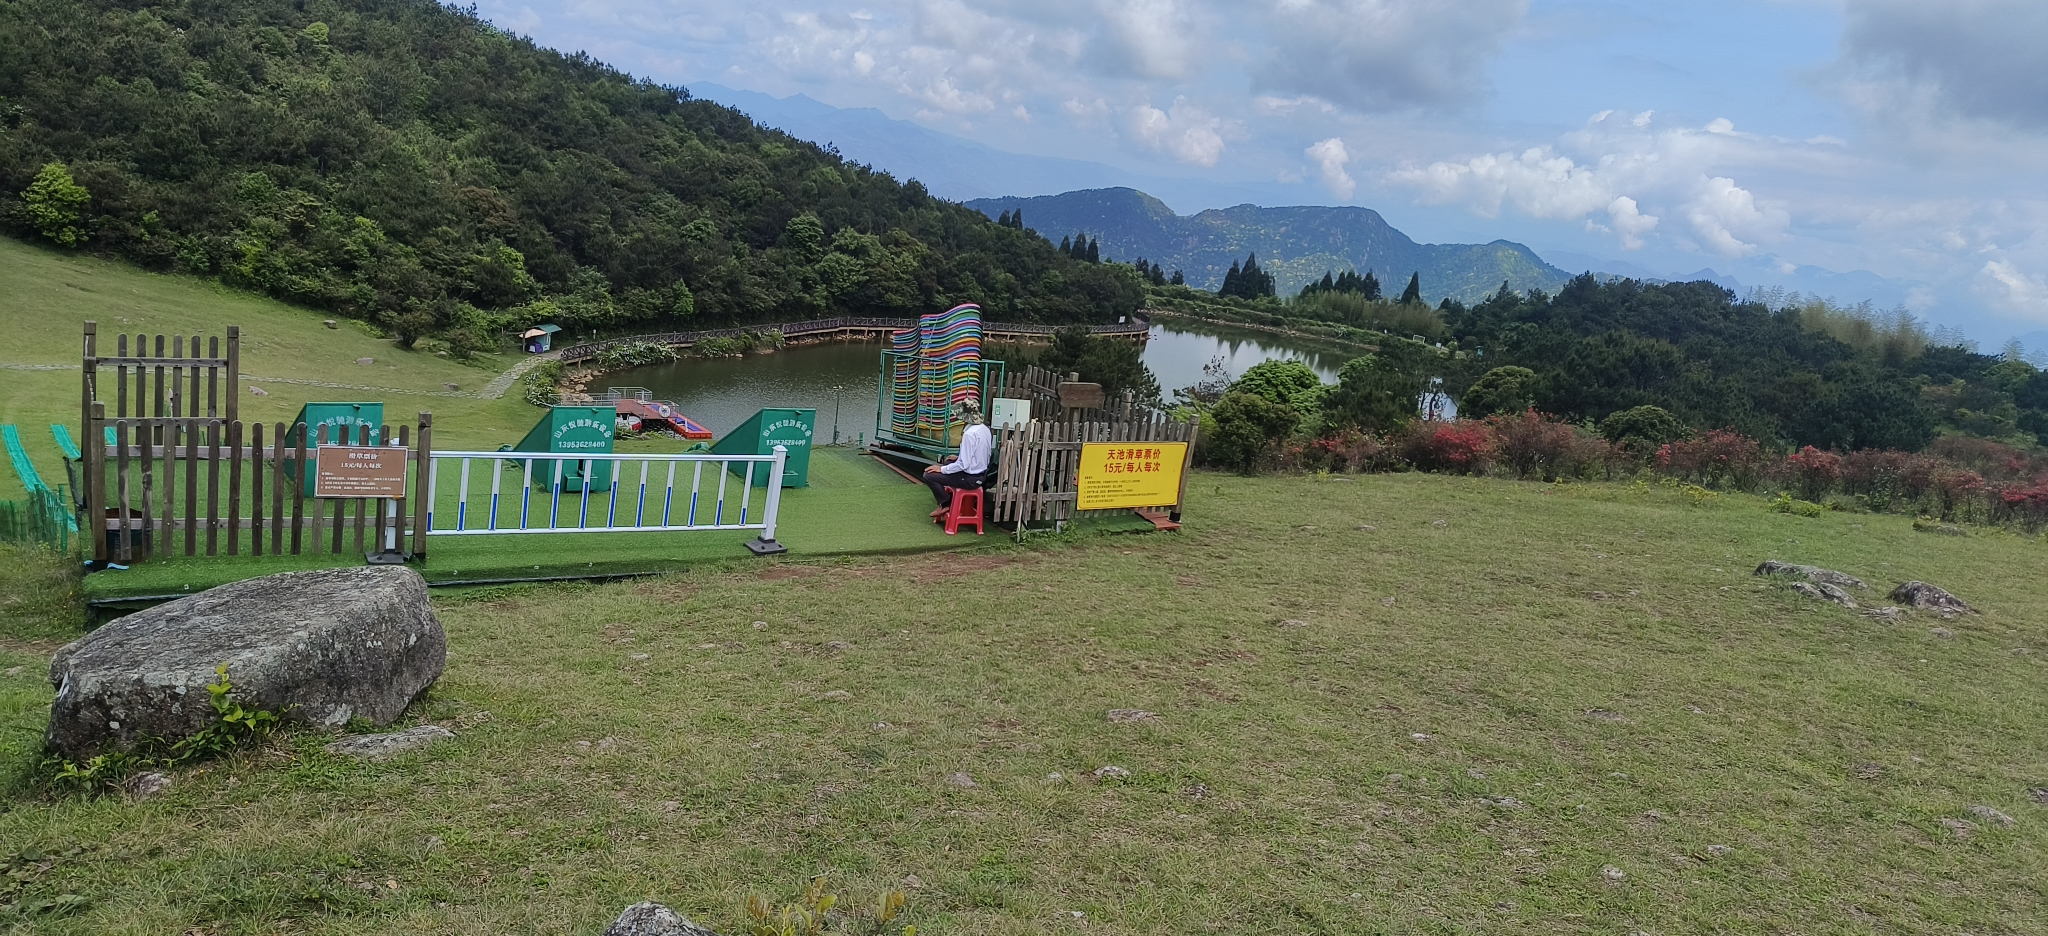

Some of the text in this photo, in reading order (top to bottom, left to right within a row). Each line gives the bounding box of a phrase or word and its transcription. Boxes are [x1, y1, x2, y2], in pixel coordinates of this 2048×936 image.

[1107, 448, 1161, 460] 天池滑草票价
[1104, 461, 1161, 473] 15元/每人每次
